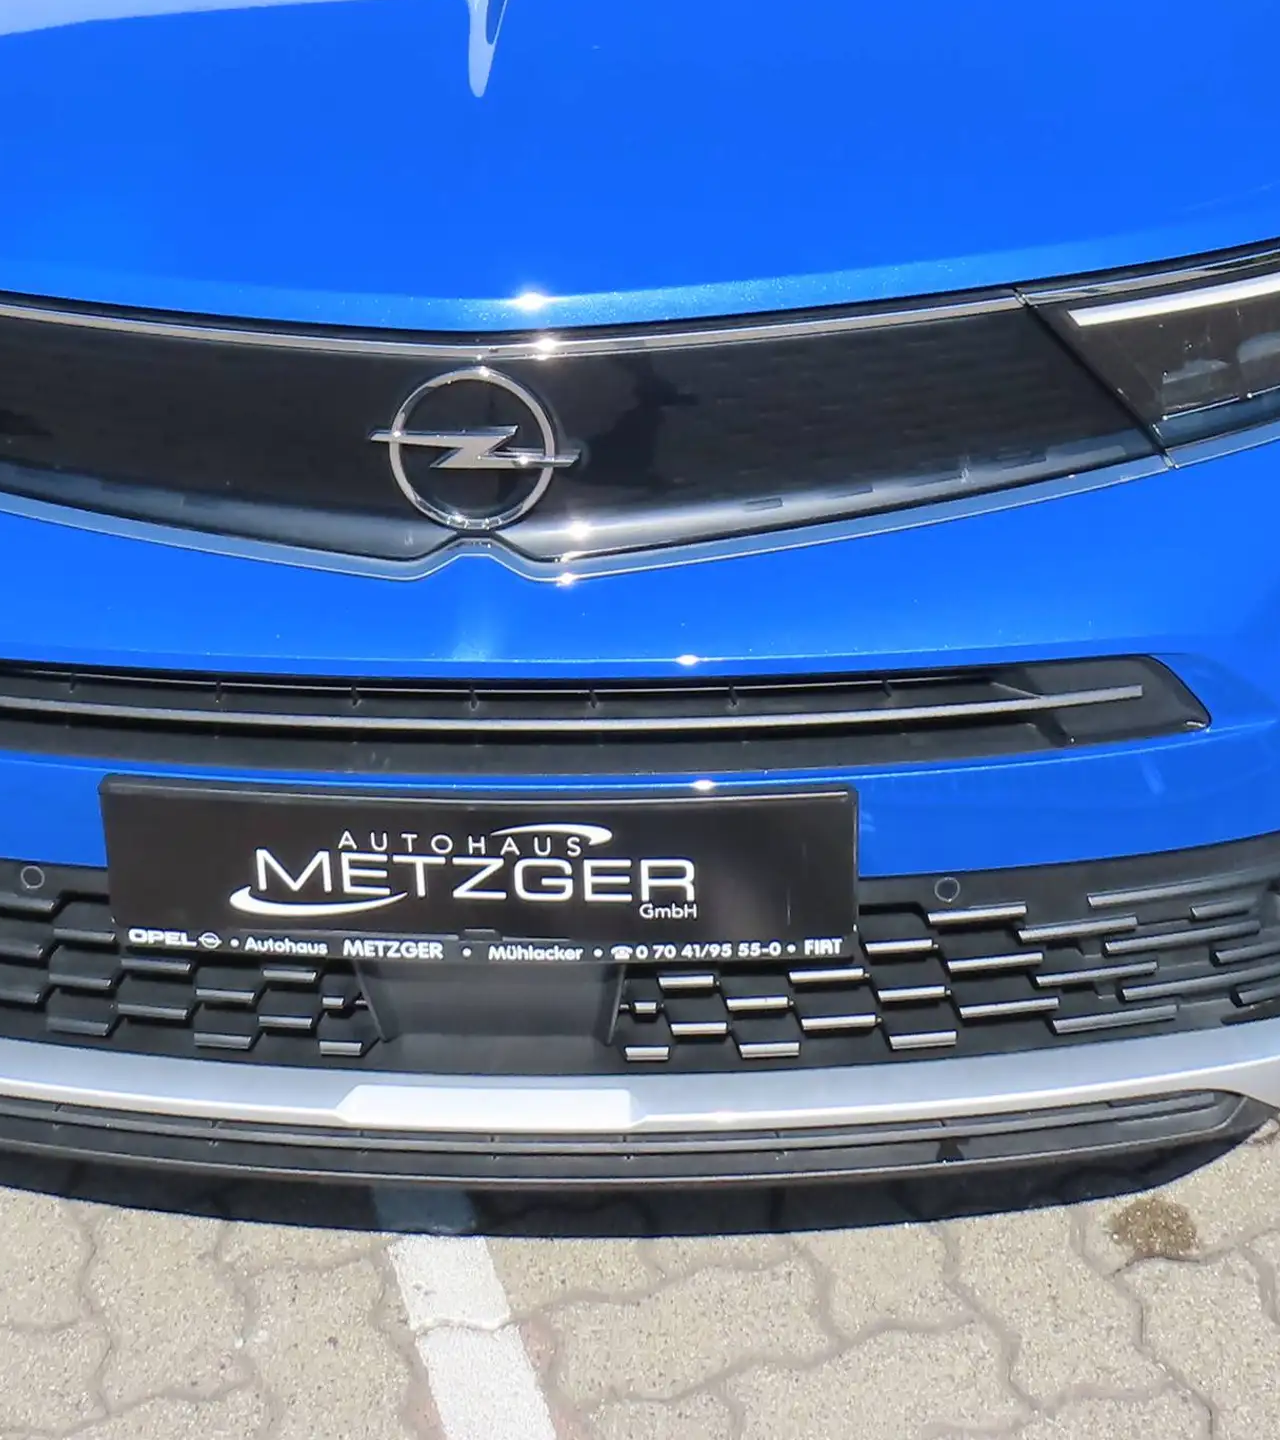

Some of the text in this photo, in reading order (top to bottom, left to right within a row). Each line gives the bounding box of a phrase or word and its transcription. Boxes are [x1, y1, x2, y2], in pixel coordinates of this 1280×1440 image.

[337, 830, 582, 856] AUTOHAUS
[257, 849, 698, 902] METZGER
[638, 902, 699, 921] GmbH
[127, 928, 198, 948] OPEL
[244, 936, 328, 956] Autohaus
[342, 938, 445, 960] METZGER
[487, 944, 584, 962] Mühlacker
[652, 943, 677, 961] 70
[681, 941, 733, 960] 41/95
[737, 940, 782, 959] 55-0
[803, 937, 844, 956] FIAT
